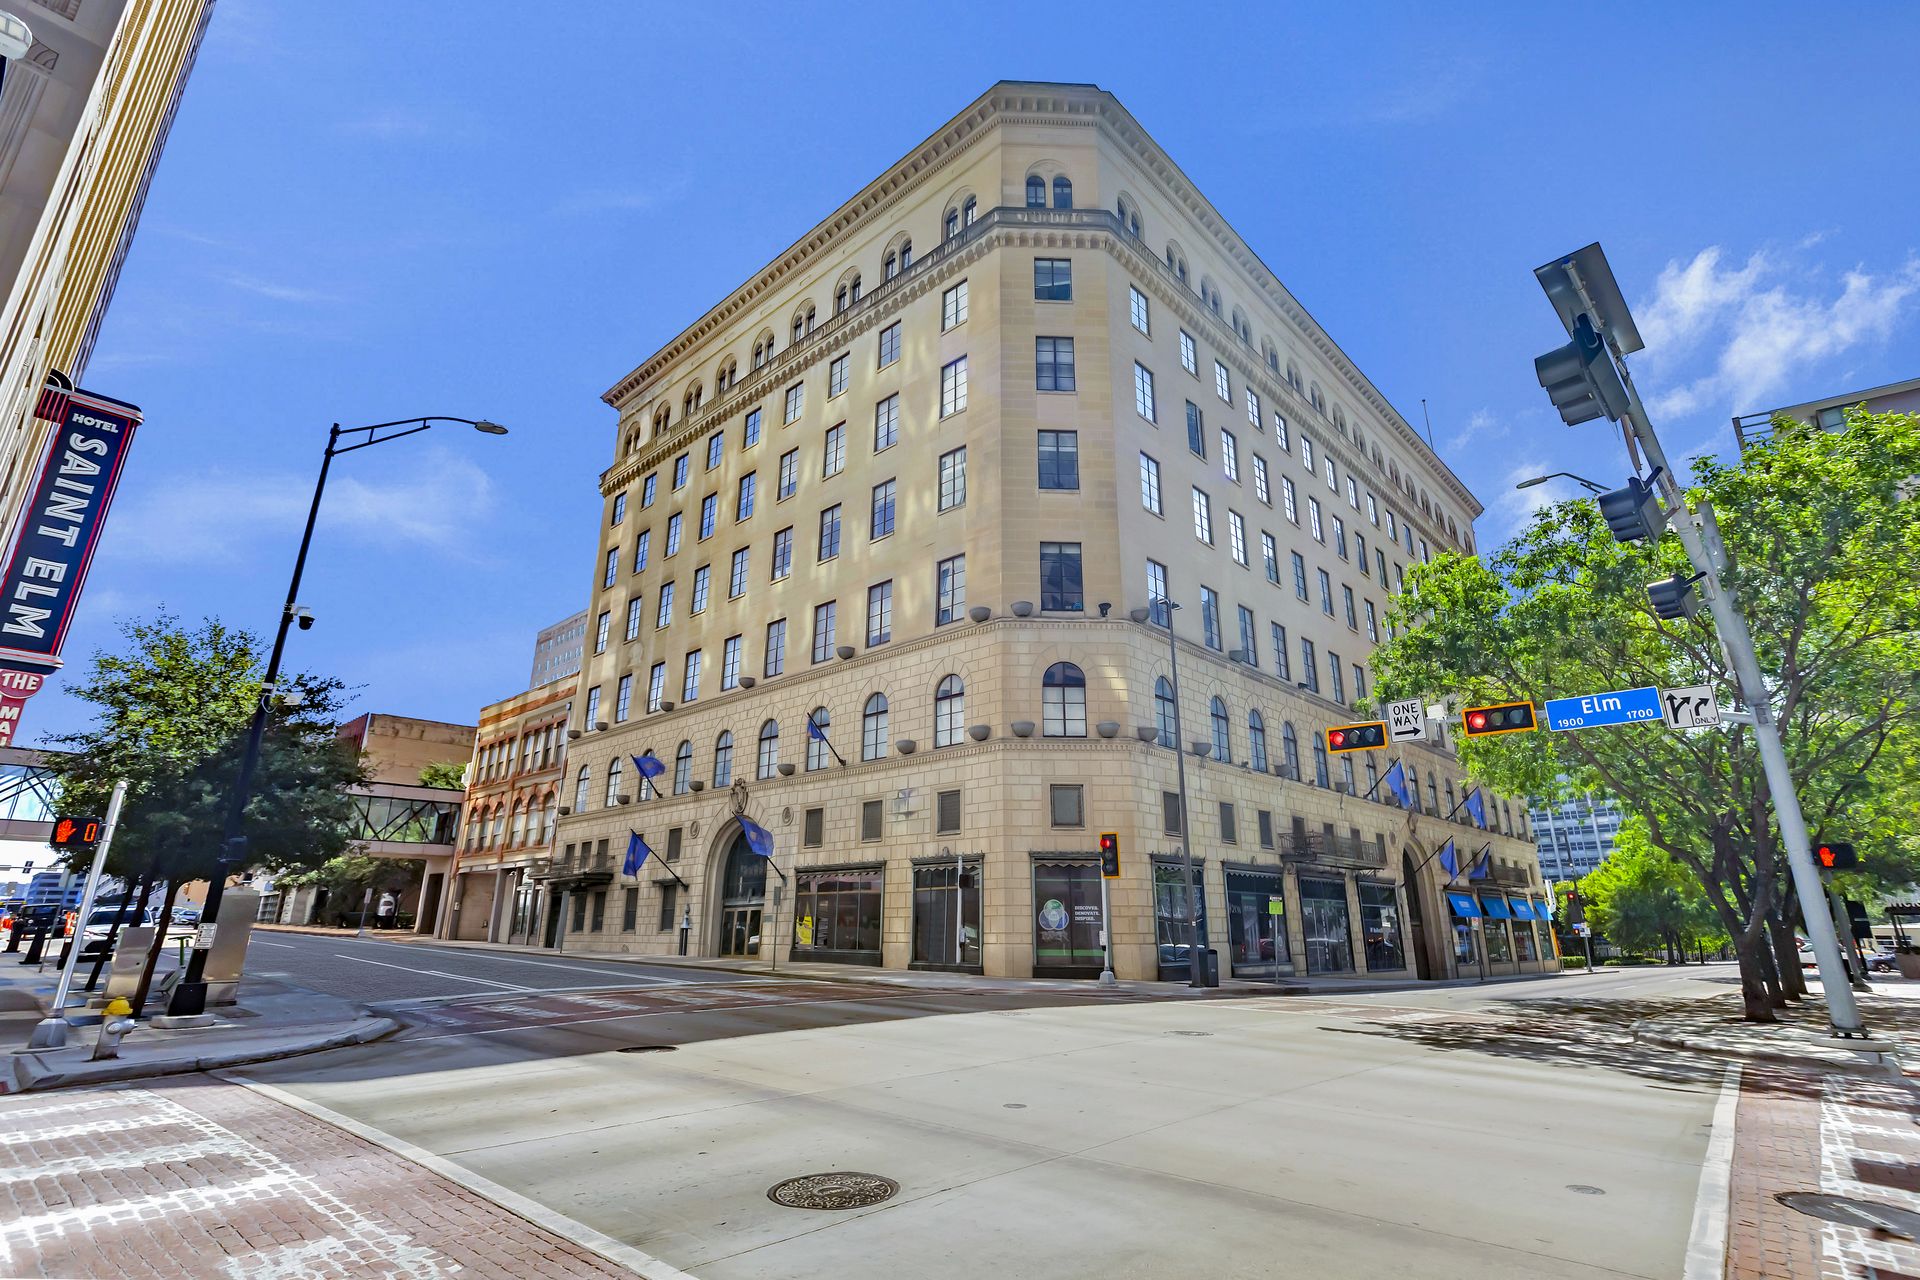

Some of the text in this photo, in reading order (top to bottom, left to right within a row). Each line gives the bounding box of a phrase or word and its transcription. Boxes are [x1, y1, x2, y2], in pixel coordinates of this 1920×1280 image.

[72, 413, 119, 433] HOTEL
[1, 432, 108, 639] SAINT ELM
[2, 672, 40, 690] THE
[1393, 703, 1418, 715] ONE
[1581, 697, 1622, 714] Elm
[1393, 714, 1419, 727] WAY
[1626, 708, 1654, 719] 1700
[1695, 716, 1717, 725] ONLY
[1558, 717, 1584, 728] 1900
[84, 823, 97, 842] 0
